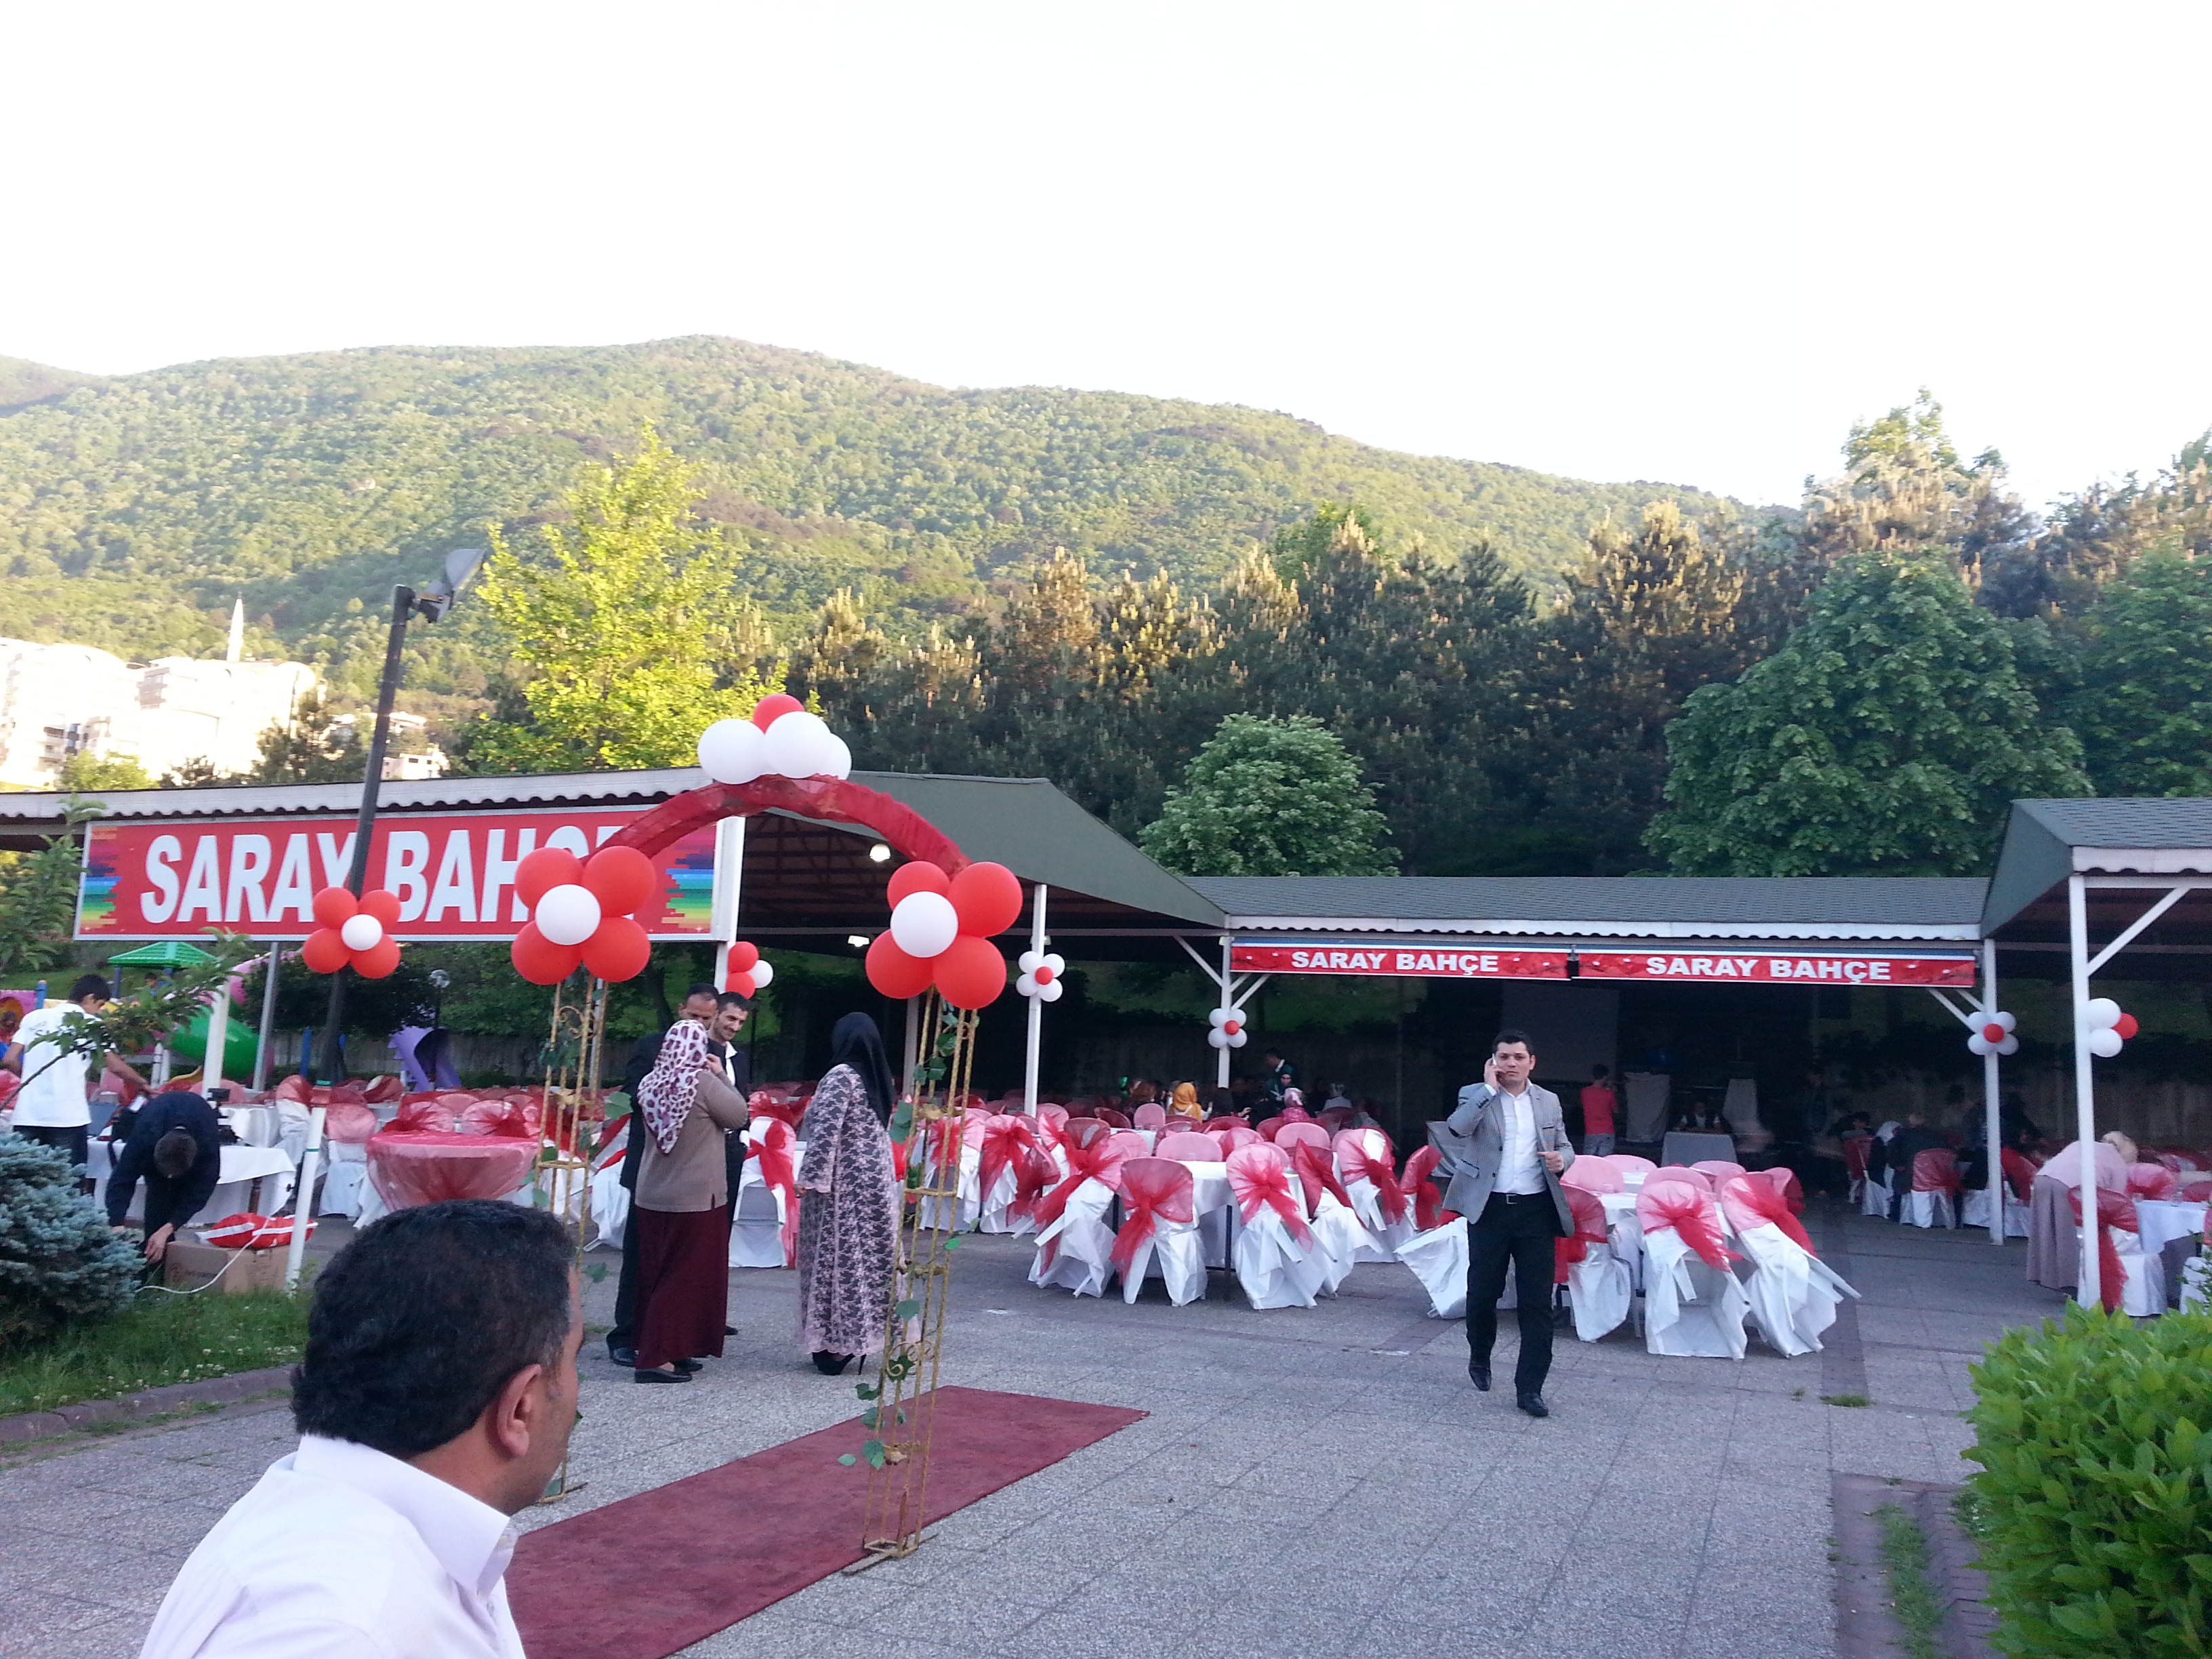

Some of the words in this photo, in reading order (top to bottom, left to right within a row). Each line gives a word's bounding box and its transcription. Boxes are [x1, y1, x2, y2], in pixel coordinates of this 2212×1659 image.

[140, 832, 359, 924] SARAY
[384, 825, 635, 922] BAH
[1291, 951, 1387, 970] SARAY
[1395, 953, 1498, 976] BAHÇE
[1645, 957, 1759, 977] SARAY
[1769, 959, 1891, 984] BAHÇE
